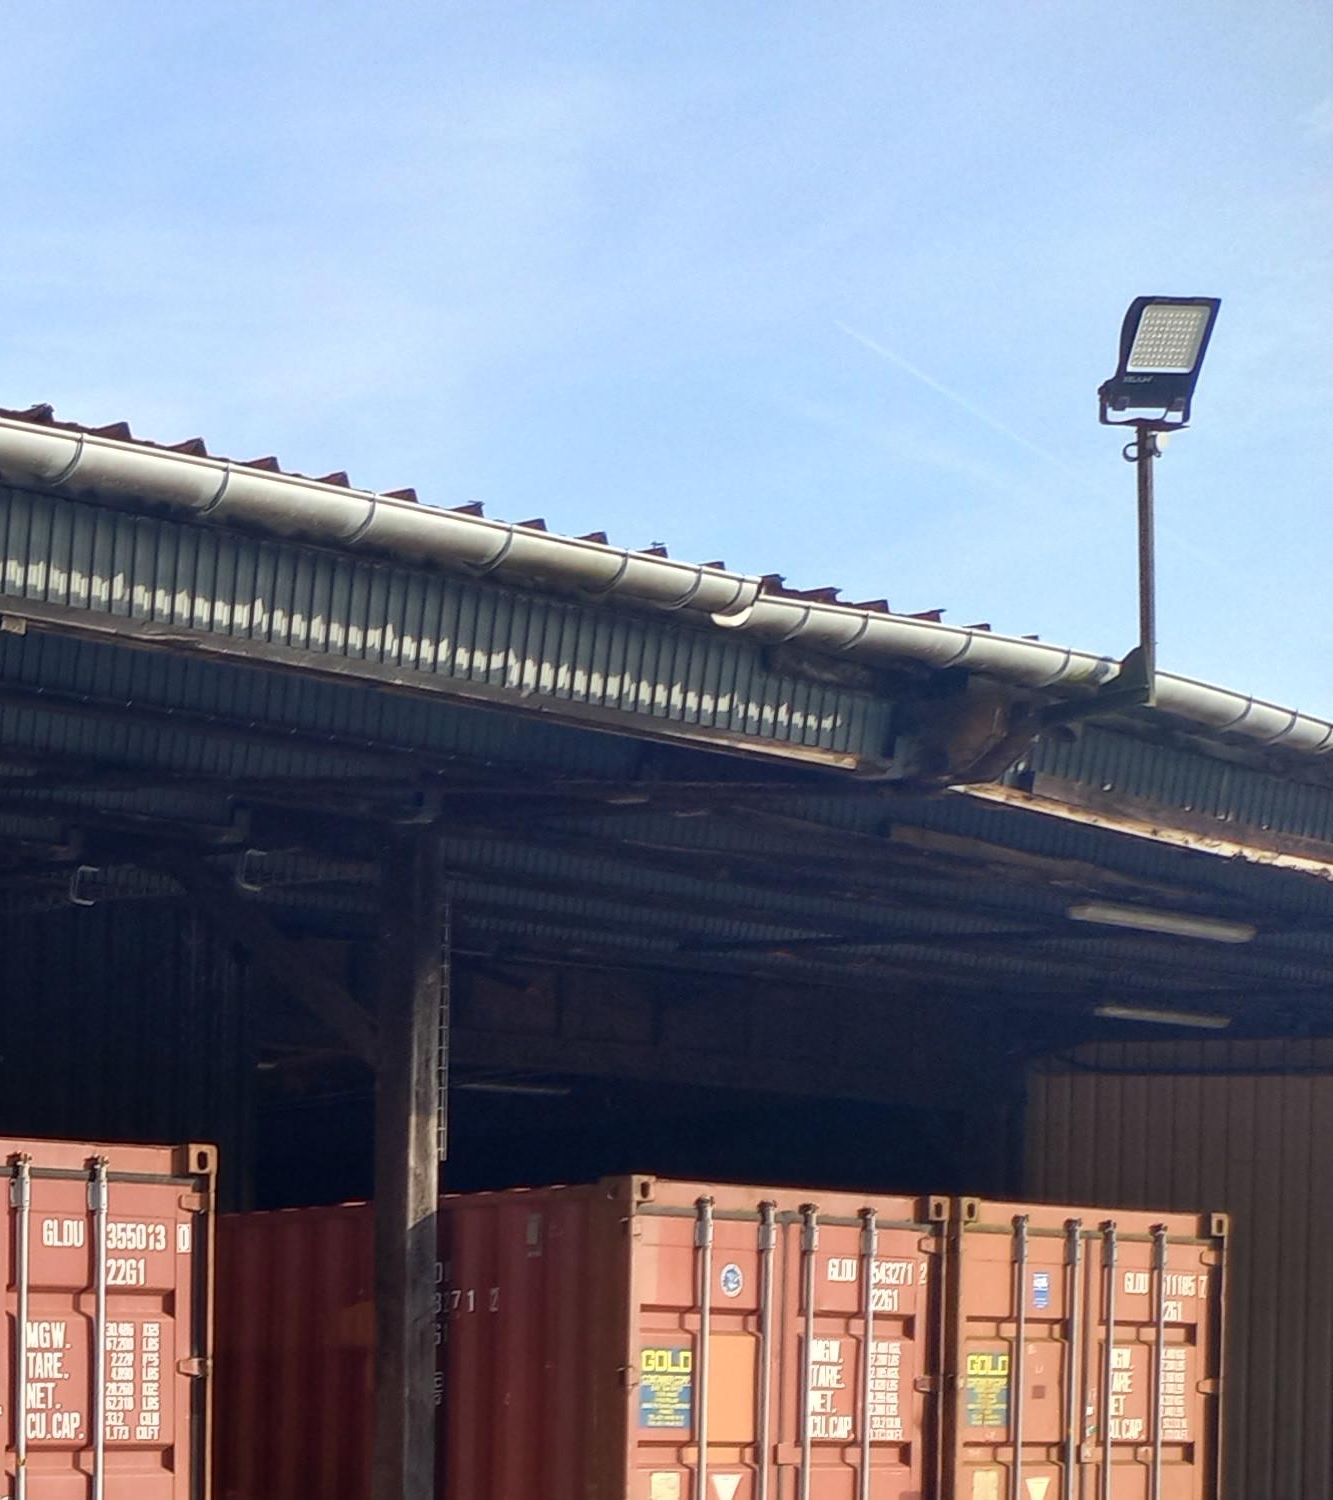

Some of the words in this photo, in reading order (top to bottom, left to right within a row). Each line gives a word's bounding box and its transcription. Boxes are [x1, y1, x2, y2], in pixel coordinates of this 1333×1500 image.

[42, 1219, 84, 1247] GLDU
[107, 1223, 166, 1250] 355013
[106, 1258, 145, 1286] 22G1
[828, 1258, 857, 1281] GLDU
[26, 1322, 71, 1349] MGW.
[26, 1352, 69, 1379] TARE.
[642, 1350, 692, 1373] GOLD
[967, 1355, 1009, 1375] GOLD
[26, 1382, 62, 1409] NET.
[26, 1412, 85, 1439] CU.CAP.
